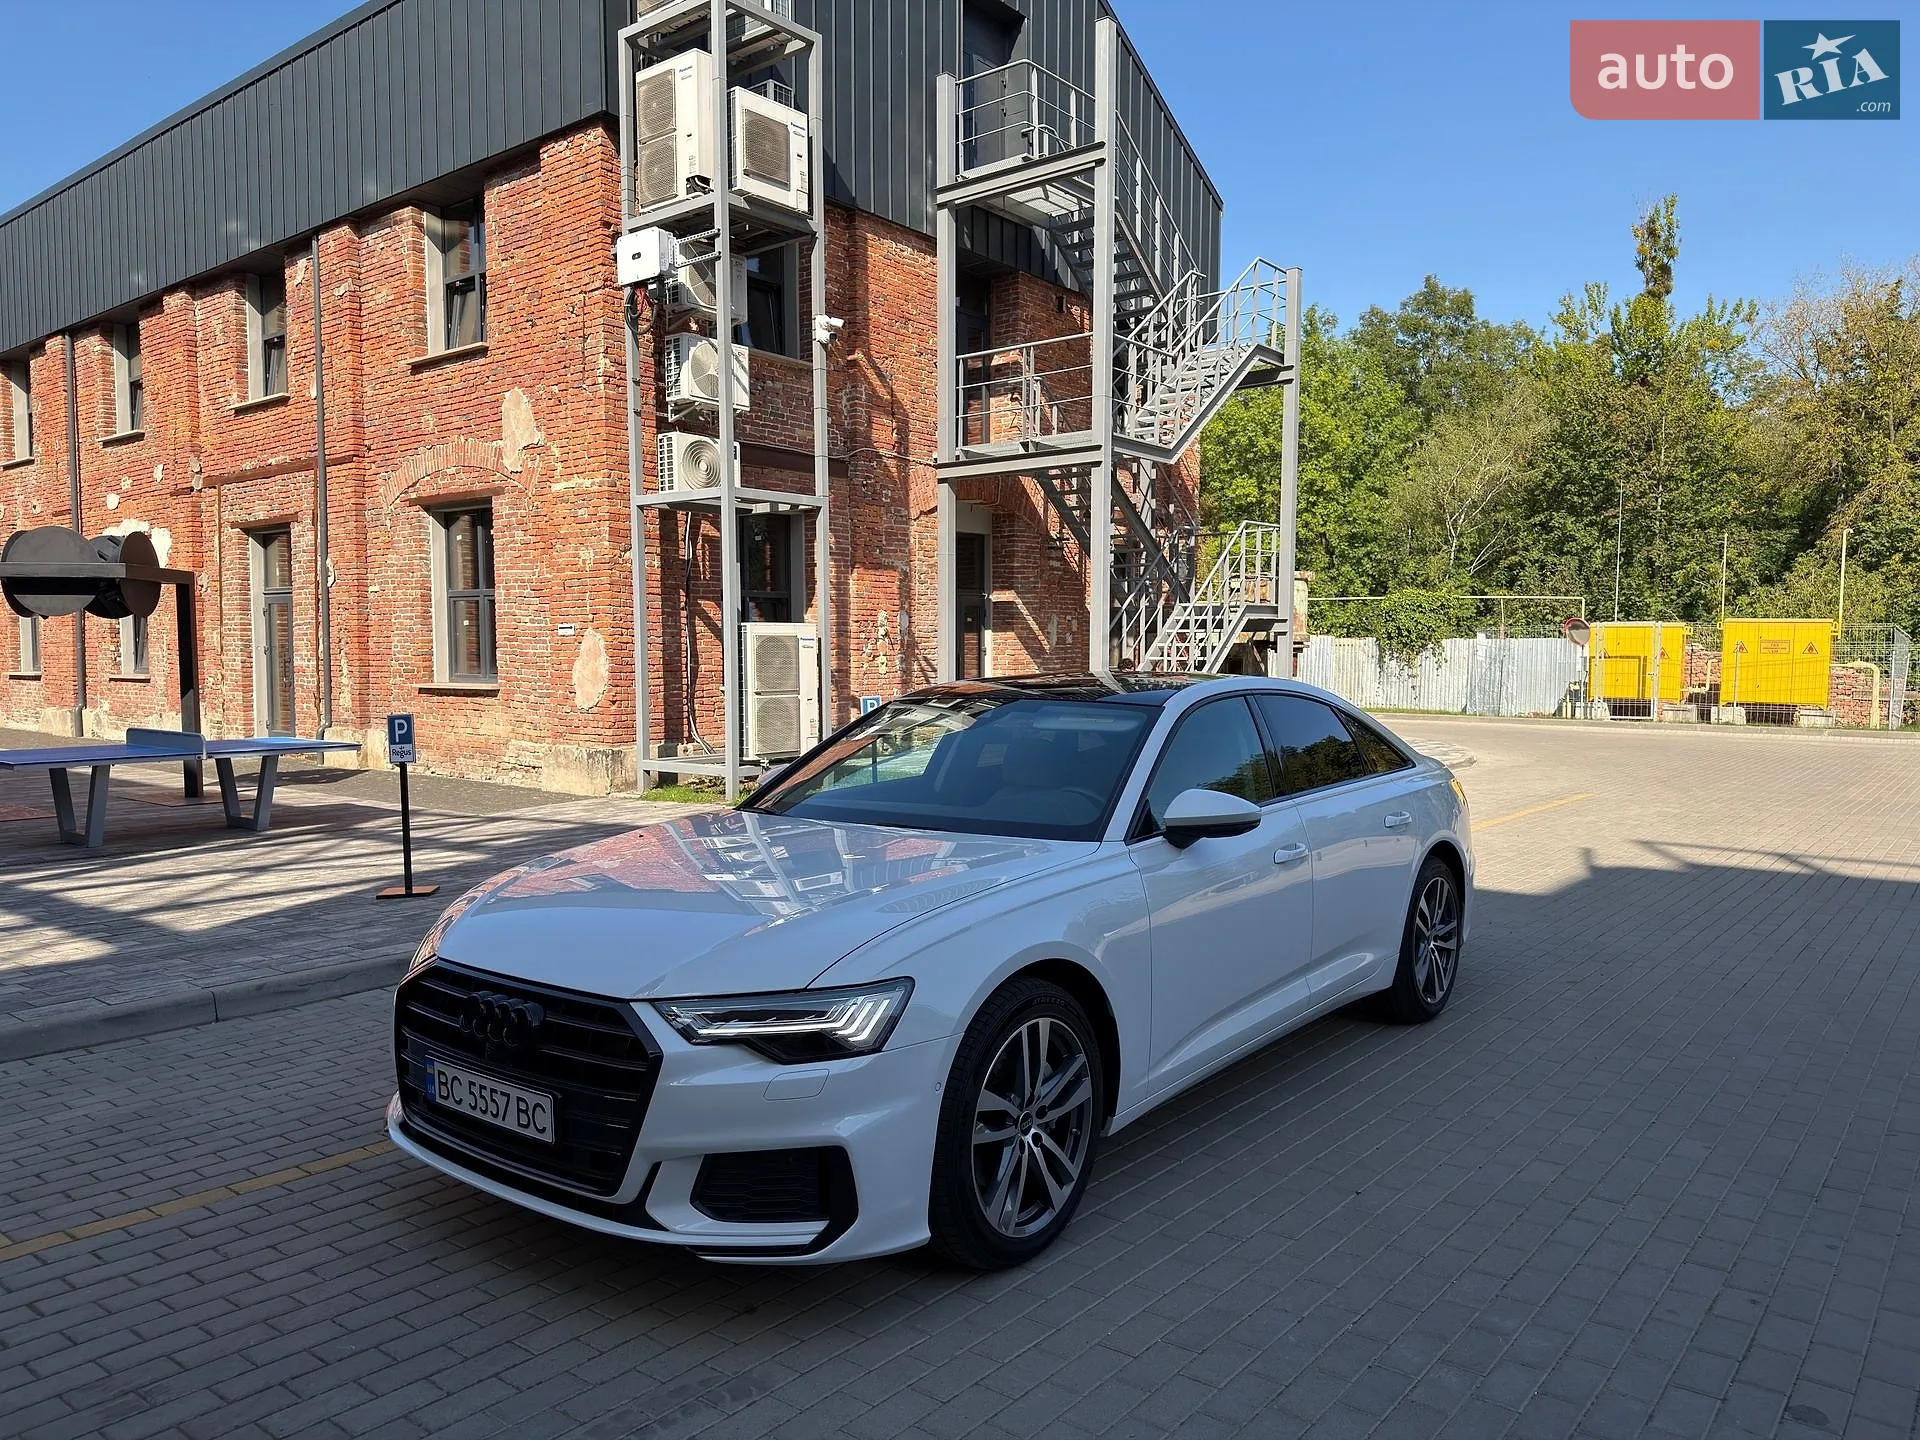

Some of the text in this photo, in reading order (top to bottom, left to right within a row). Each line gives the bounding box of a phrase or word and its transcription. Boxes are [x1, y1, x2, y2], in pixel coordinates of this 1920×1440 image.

[394, 719, 408, 743] P
[391, 748, 412, 759] Regus
[437, 1069, 547, 1134] BC 5557 BC
